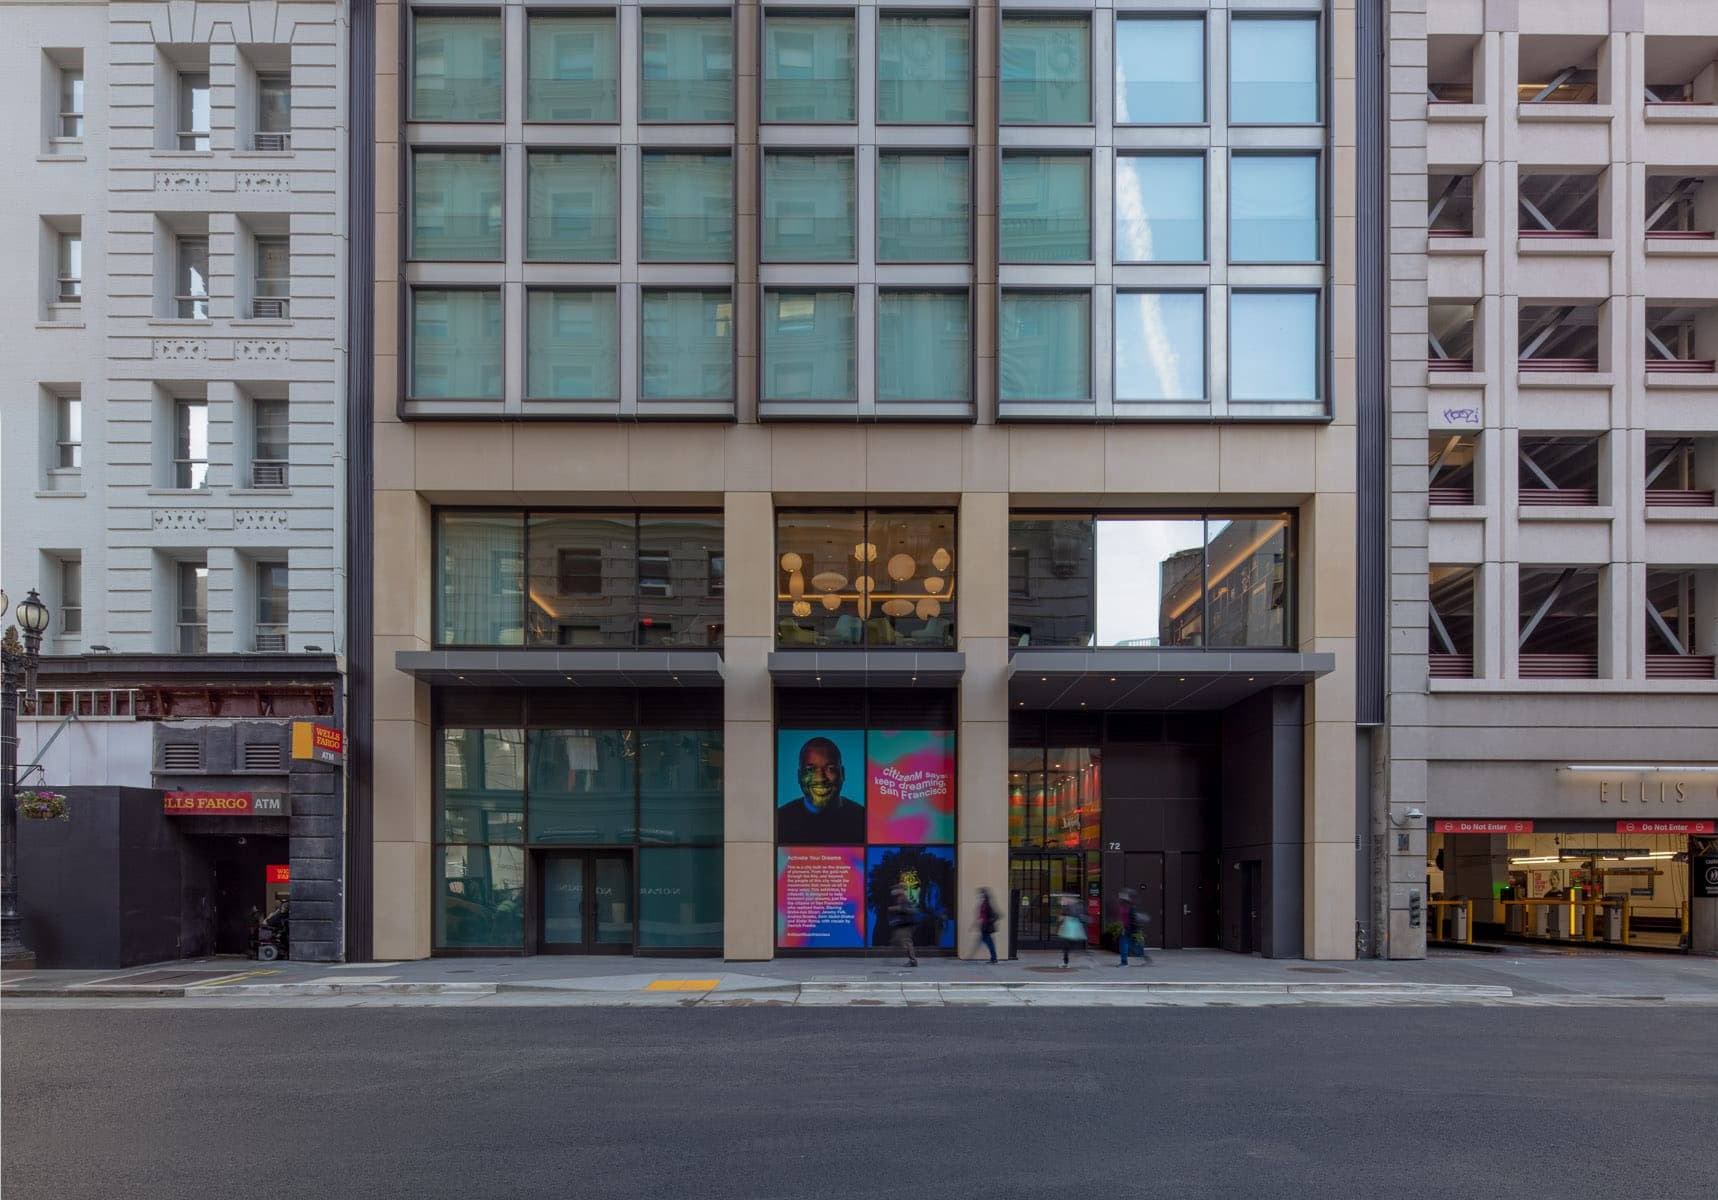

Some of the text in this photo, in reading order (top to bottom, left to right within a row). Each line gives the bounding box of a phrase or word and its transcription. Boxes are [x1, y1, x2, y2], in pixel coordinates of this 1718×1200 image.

[316, 727, 341, 742] WELLS
[316, 736, 340, 749] FARGO
[321, 751, 336, 761] ATM
[883, 766, 923, 782] citizenM
[874, 776, 896, 788] keep
[879, 786, 947, 800] San Francisco
[1600, 781, 1686, 803] ELLIS
[164, 798, 280, 809] LLS FARGO ATM
[1460, 823, 1507, 831] Do Not Enter
[1642, 823, 1689, 831] Do Not Enter
[1109, 842, 1121, 850] 72
